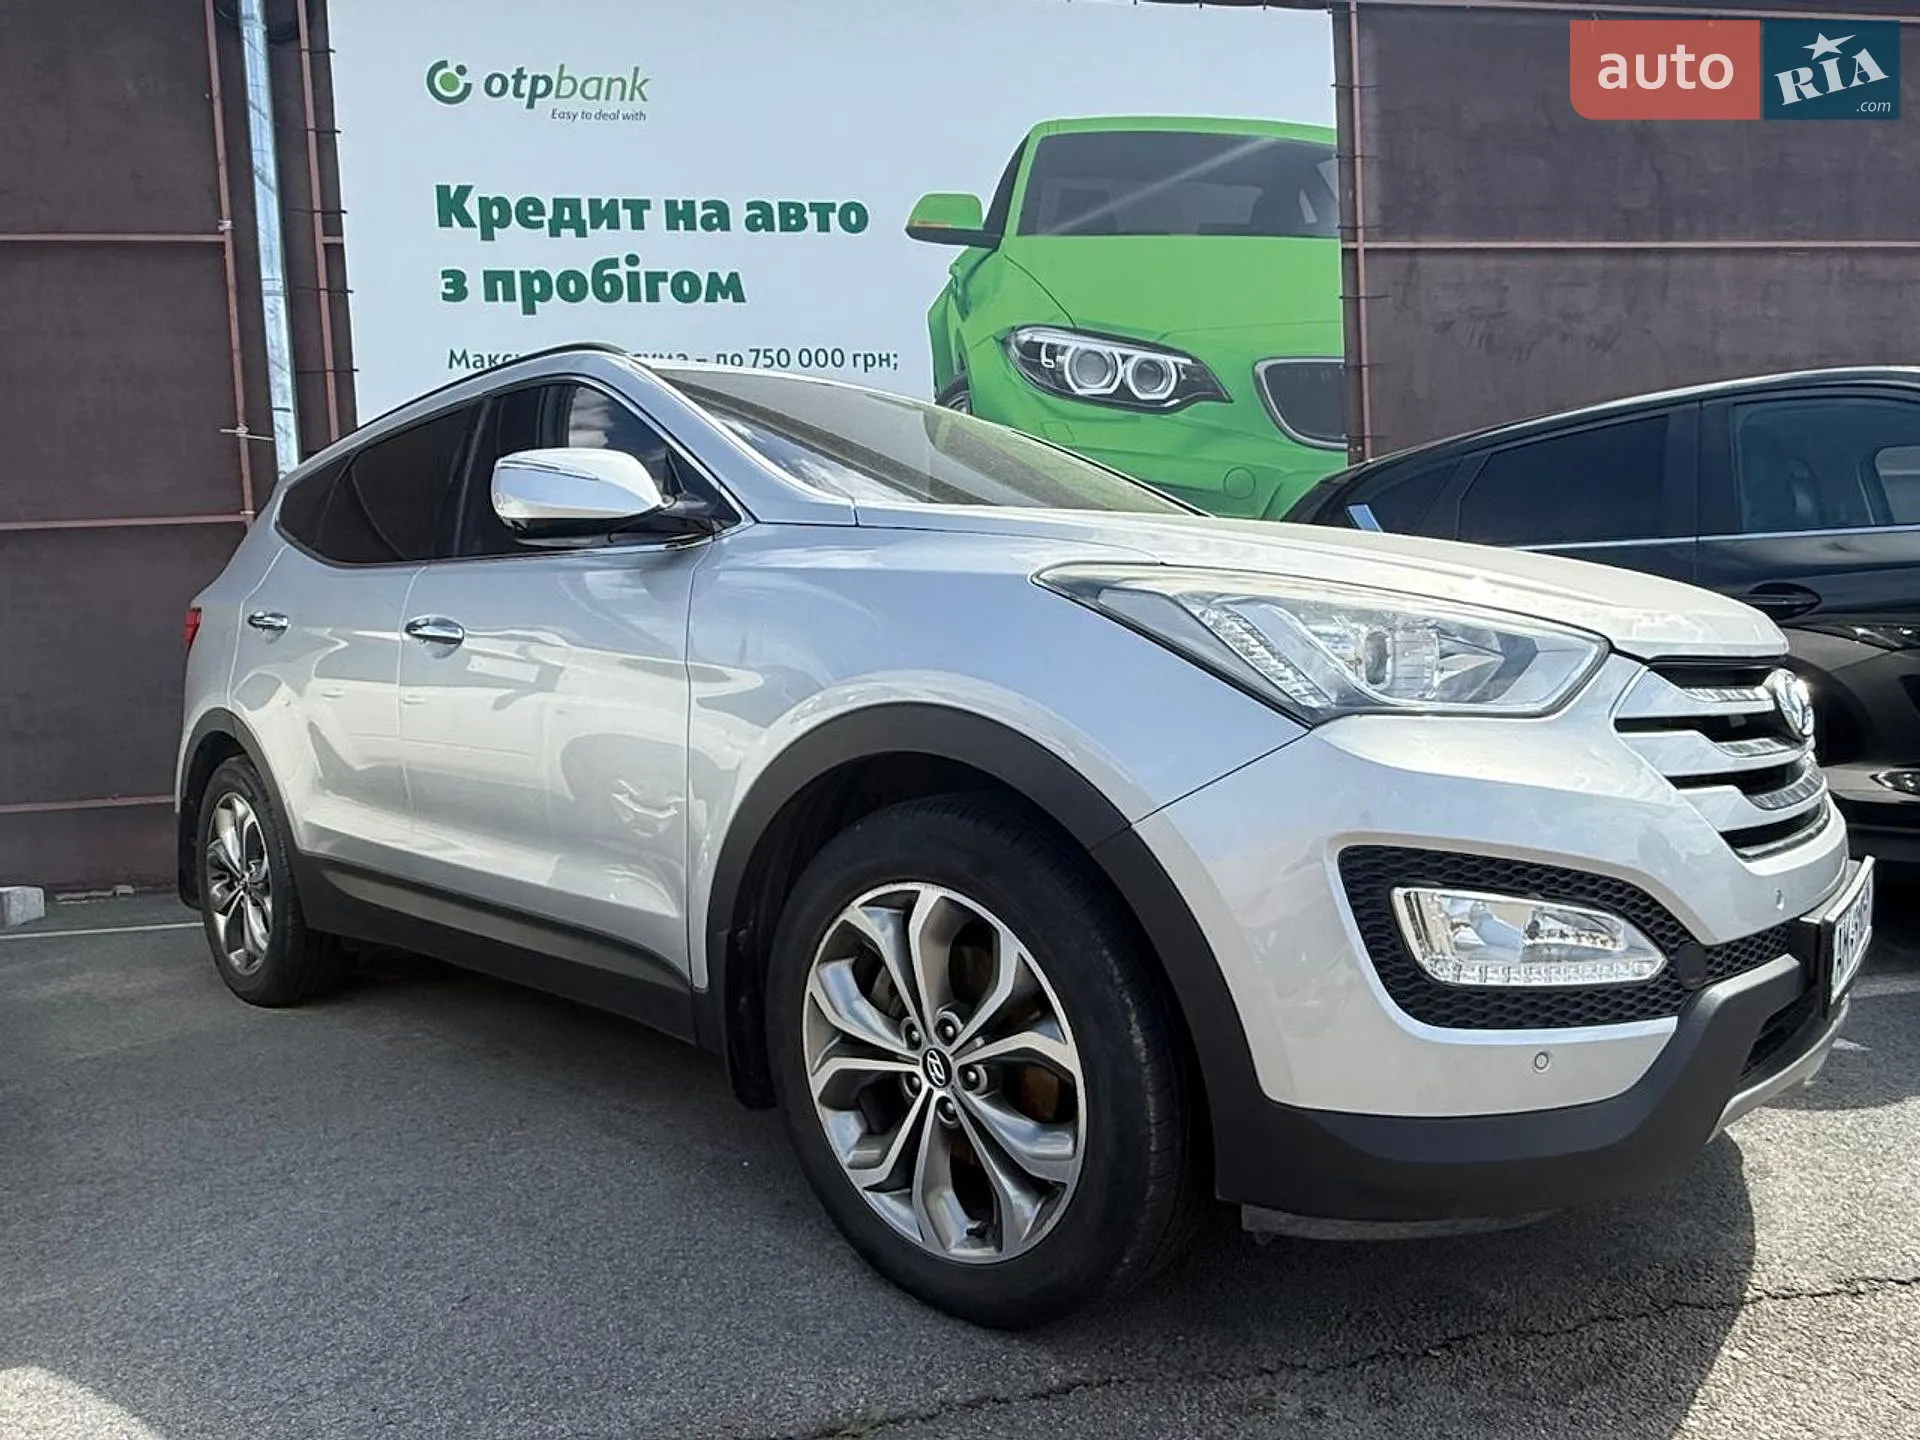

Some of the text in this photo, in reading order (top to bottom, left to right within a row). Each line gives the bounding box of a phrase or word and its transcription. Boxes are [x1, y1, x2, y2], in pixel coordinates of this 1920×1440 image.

[484, 64, 651, 109] otpbank
[551, 109, 647, 122] Easy to deal with
[435, 184, 869, 241] Кредит на авто
[441, 253, 747, 316] з пробігом
[749, 348, 791, 368] 750
[797, 347, 845, 368] 000
[853, 352, 898, 372] грн;
